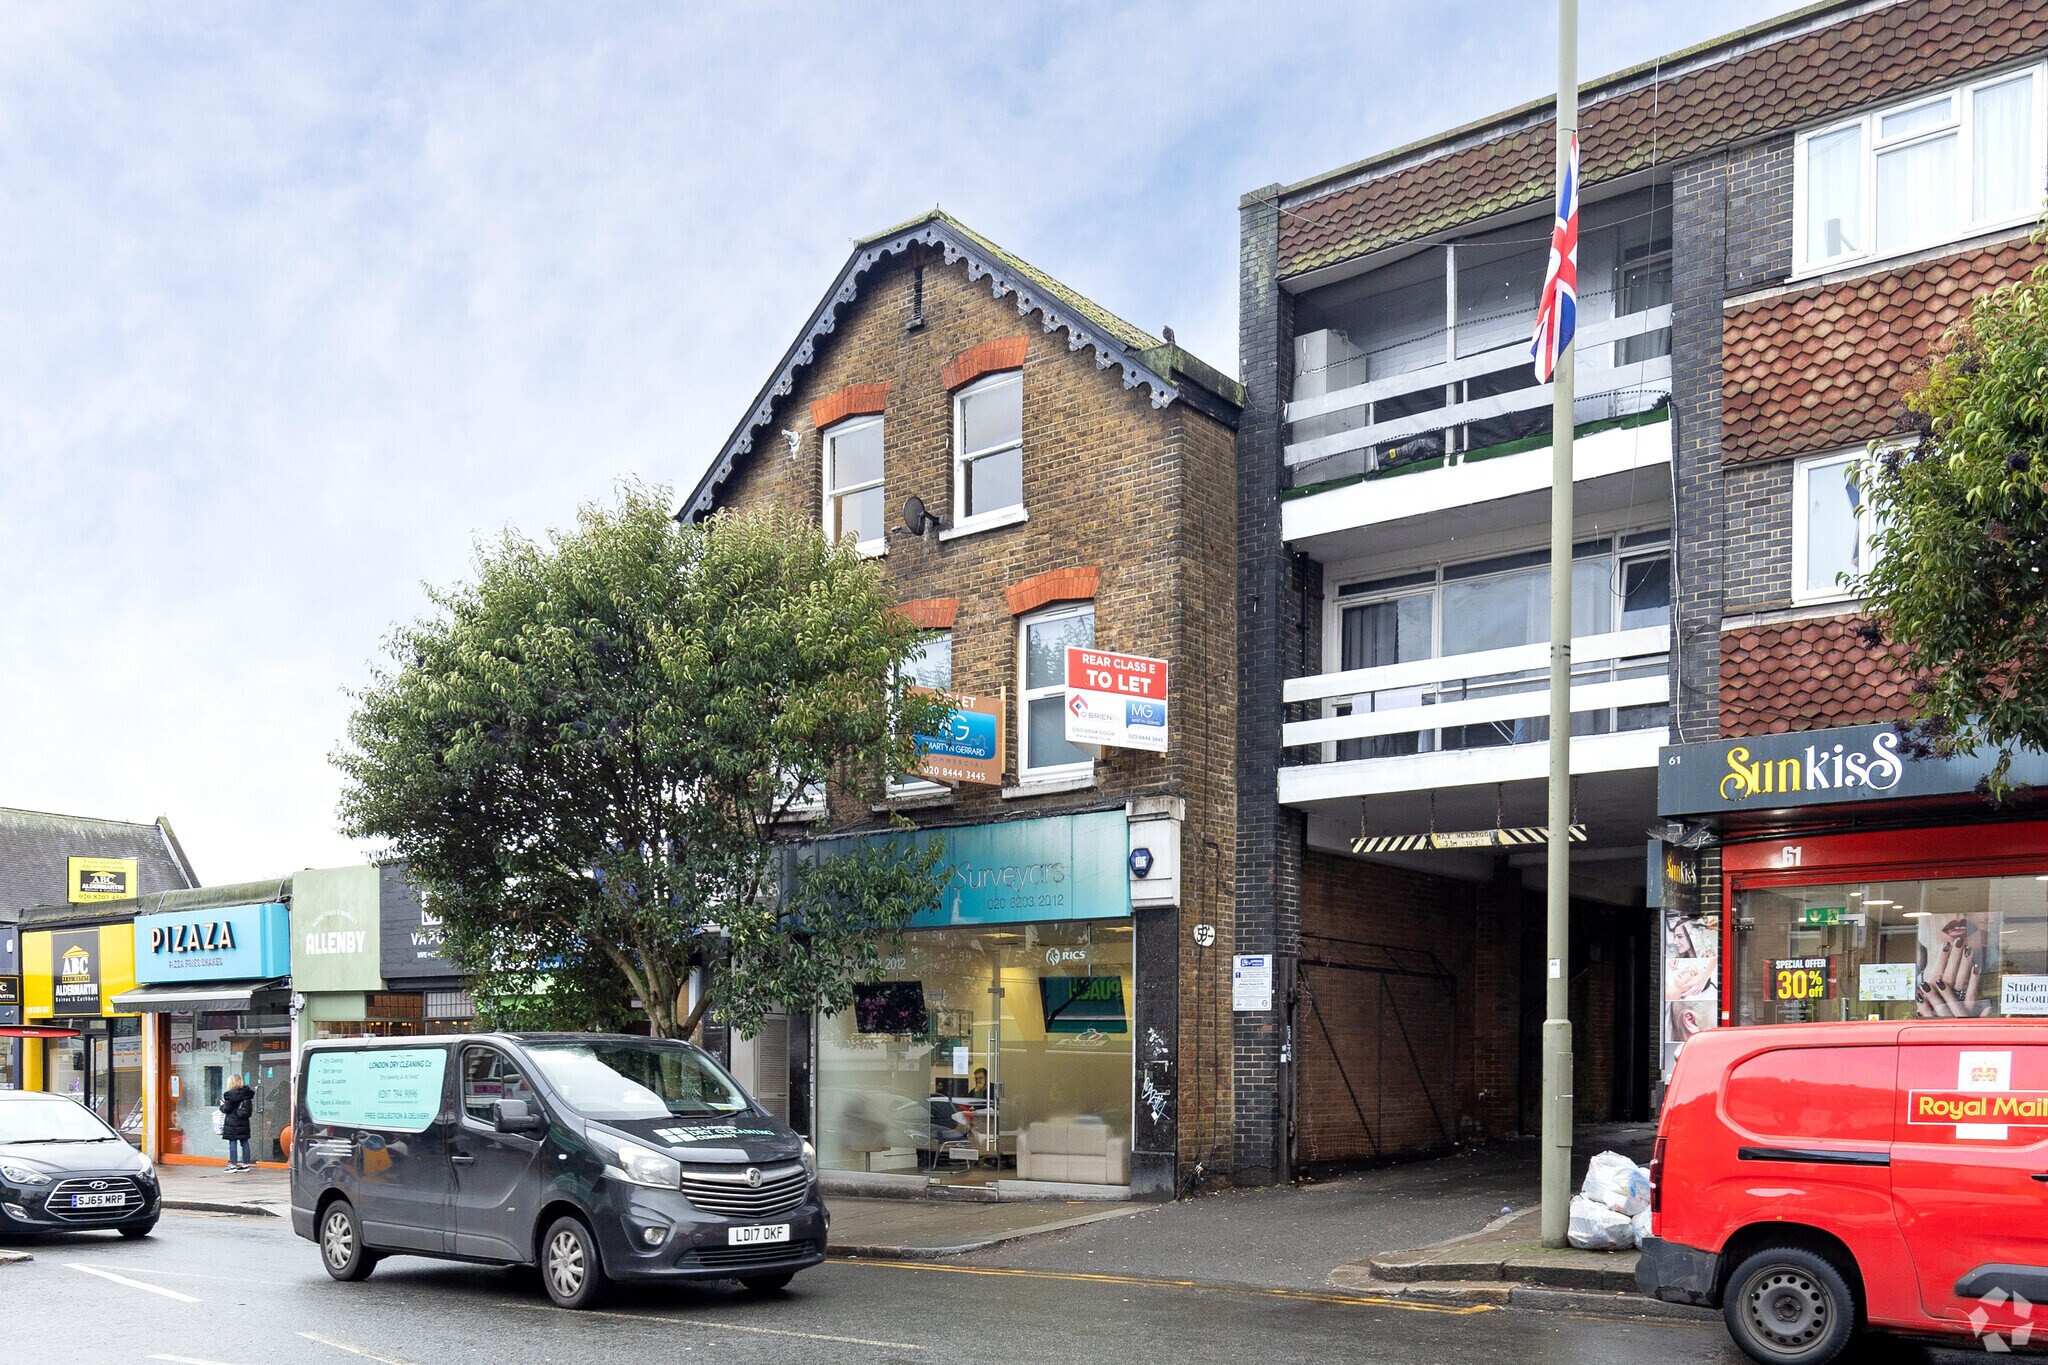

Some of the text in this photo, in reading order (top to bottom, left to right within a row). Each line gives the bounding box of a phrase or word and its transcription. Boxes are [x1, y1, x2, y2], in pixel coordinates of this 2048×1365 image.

[1082, 653, 1156, 674] REAR CLASS E
[1086, 669, 1152, 694] TO LET
[1131, 702, 1154, 718] MG
[927, 742, 985, 756] MARTYN GERRARD
[926, 755, 984, 768] OMMERCIAL
[1668, 755, 1681, 766] 61
[924, 766, 986, 780] 020 8444 3445
[1782, 847, 1802, 866] 61
[987, 894, 1064, 910] 020 8203 2012
[151, 921, 236, 954] PIZAZA
[306, 931, 366, 955] ALLENBY
[1062, 951, 1086, 960] RICS
[62, 957, 88, 974] ABC
[885, 958, 906, 969] 2012
[1776, 959, 1826, 969] SPECIAL OFFER
[56, 983, 98, 996] ALDERMARTIN
[1778, 971, 1822, 999] 30 %
[1809, 986, 1823, 998] off
[1920, 1096, 2048, 1120] Royal Mail
[78, 1194, 123, 1206] SJ65 MRP
[736, 1228, 760, 1242] LD17
